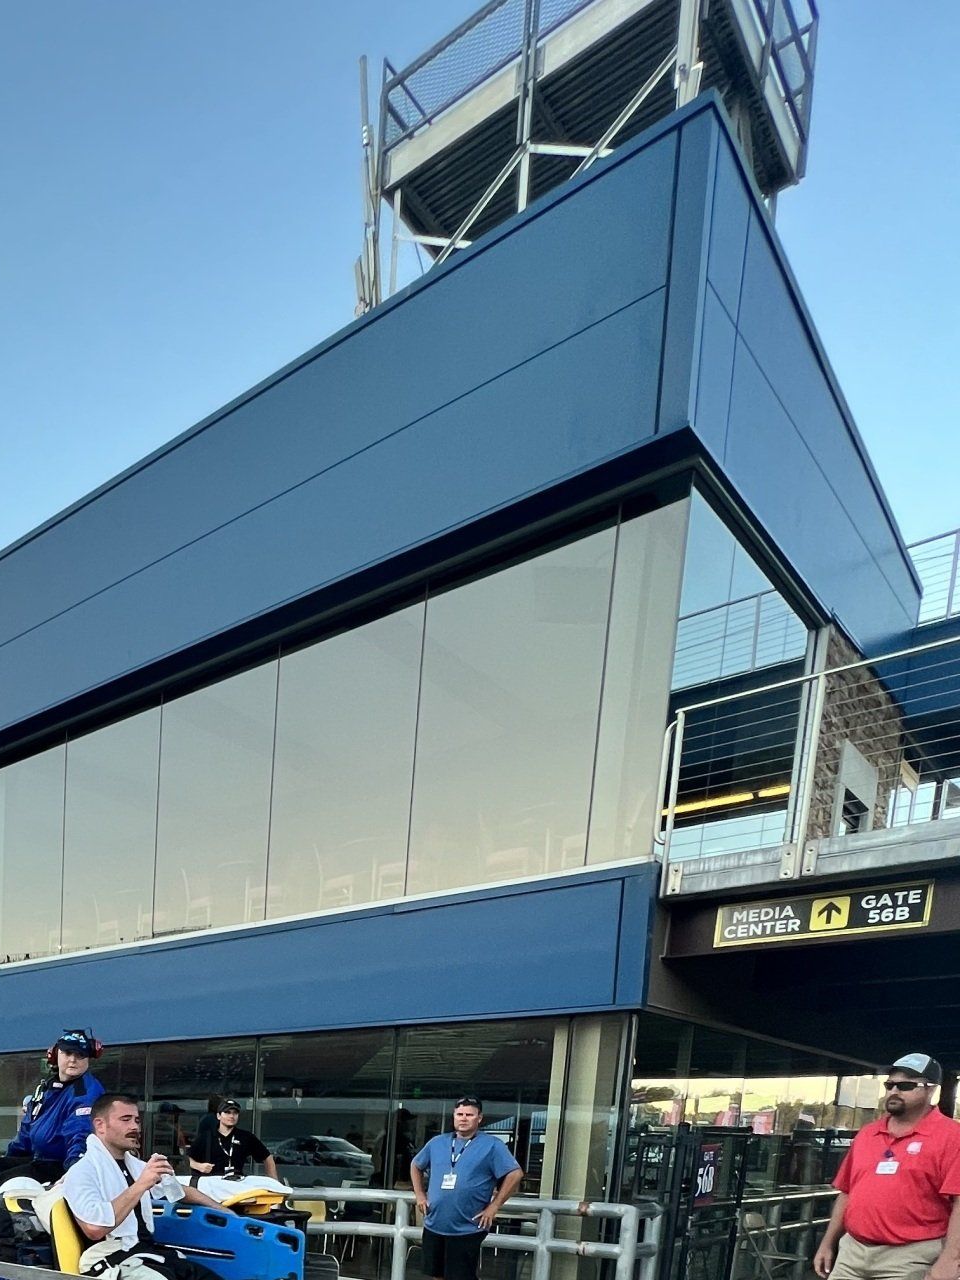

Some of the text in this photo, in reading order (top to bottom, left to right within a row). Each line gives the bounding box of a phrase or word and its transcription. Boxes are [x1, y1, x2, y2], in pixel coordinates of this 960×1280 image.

[861, 889, 923, 909] GATE
[733, 905, 795, 924] MEDIA
[867, 906, 911, 924] 56B
[723, 918, 801, 939] CENTER
